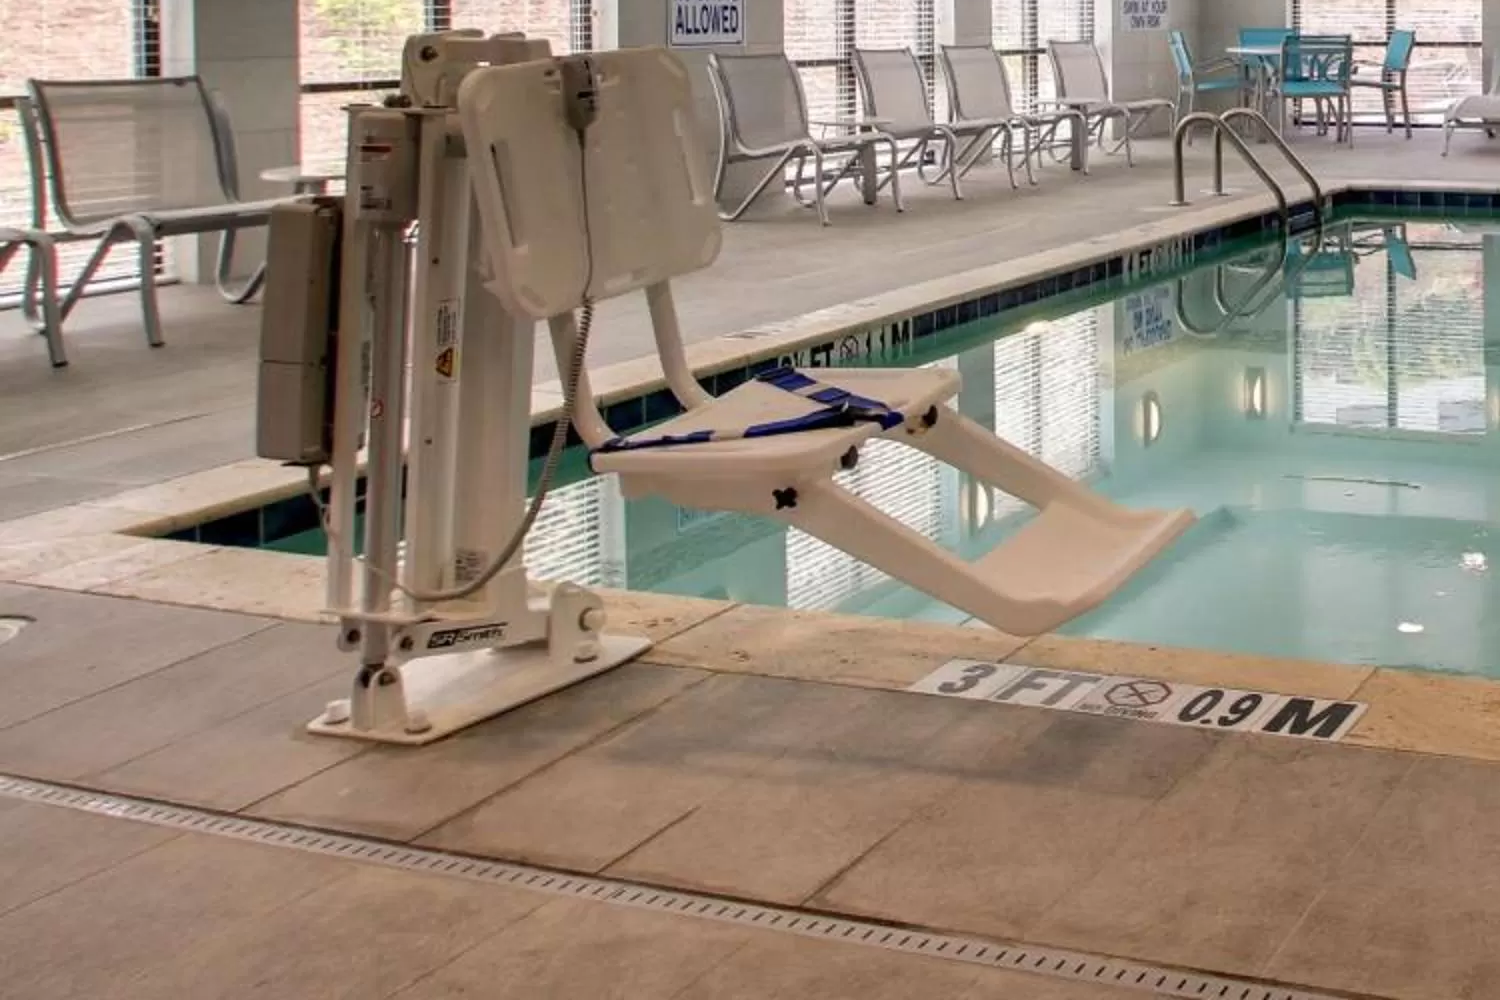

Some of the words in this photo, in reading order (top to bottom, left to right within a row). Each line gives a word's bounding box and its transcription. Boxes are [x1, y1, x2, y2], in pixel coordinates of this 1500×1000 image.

[675, 4, 739, 34] ALLOWED
[938, 663, 998, 694] 3
[997, 669, 1104, 706] FT
[1177, 689, 1264, 727] 0.9
[1261, 697, 1358, 739] M
